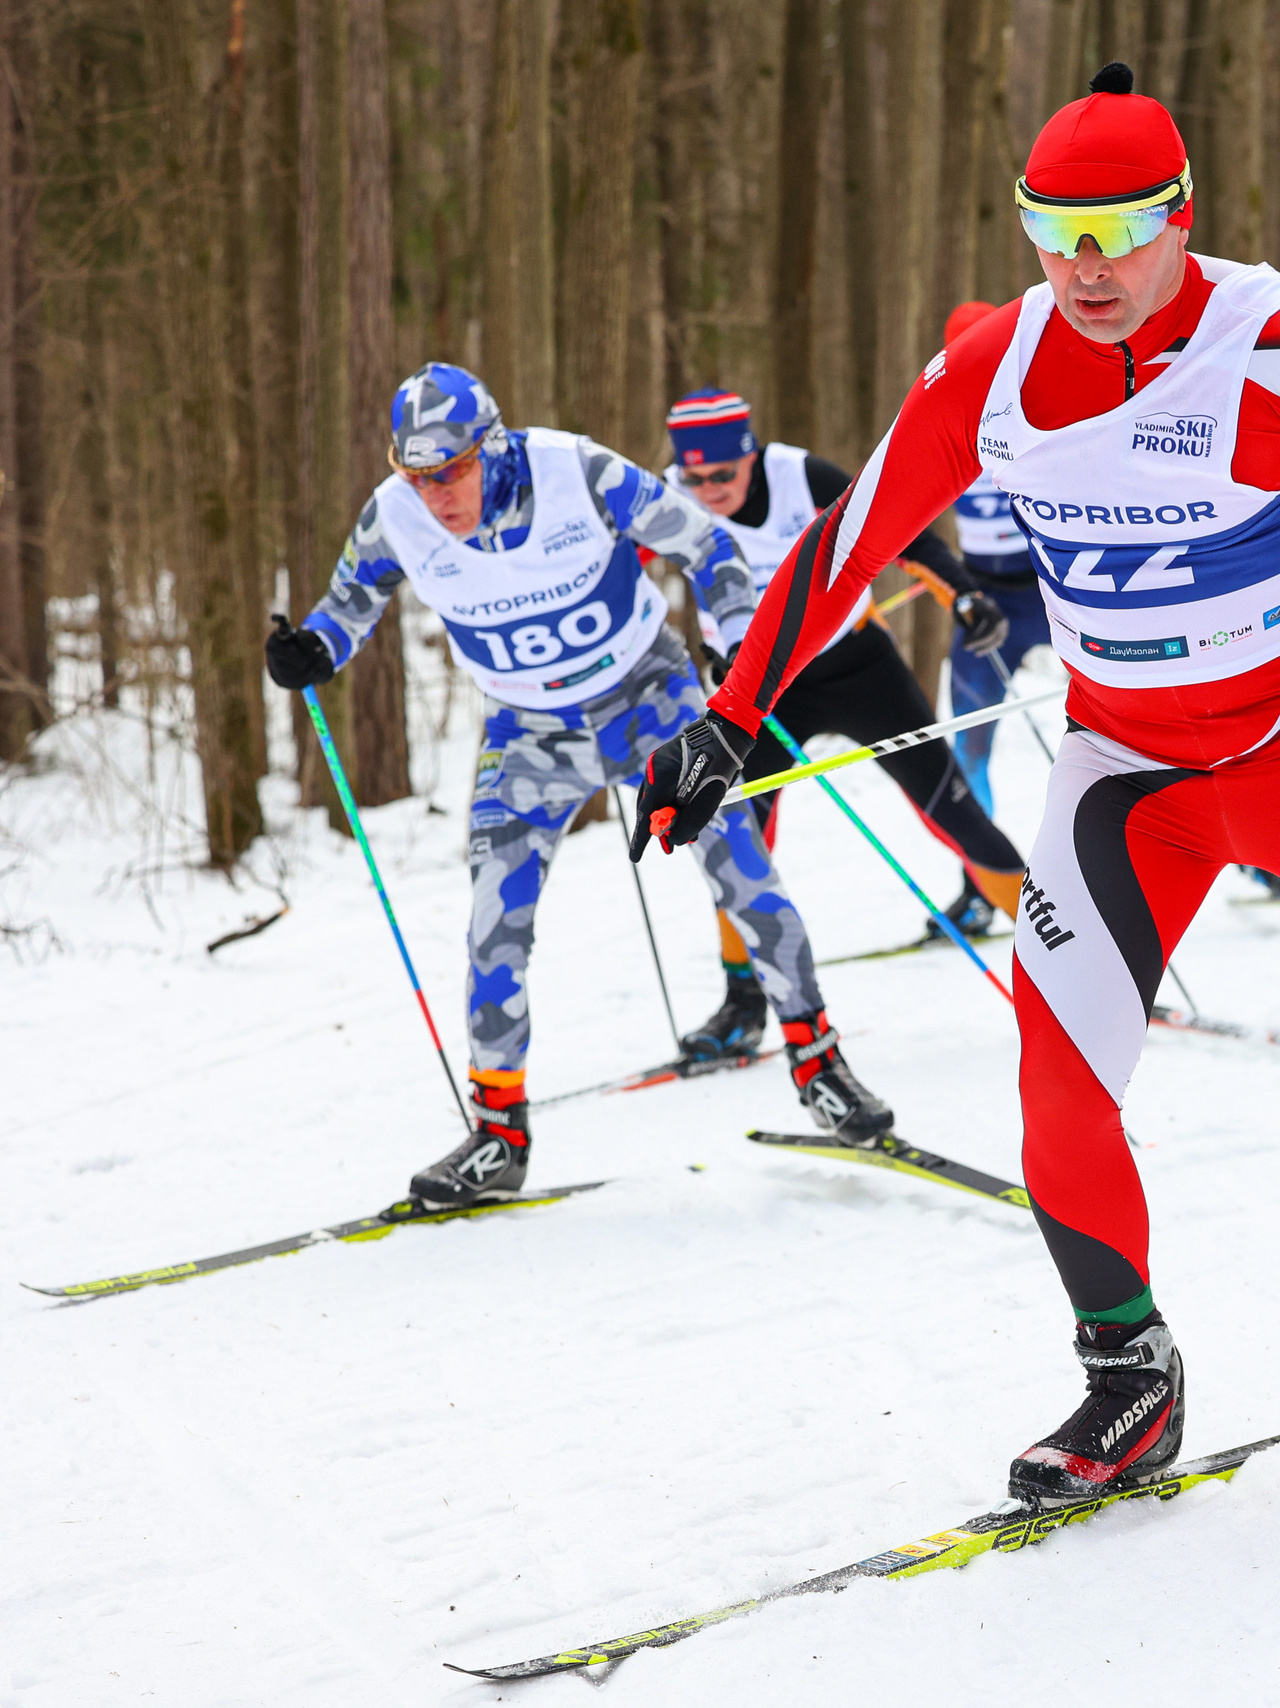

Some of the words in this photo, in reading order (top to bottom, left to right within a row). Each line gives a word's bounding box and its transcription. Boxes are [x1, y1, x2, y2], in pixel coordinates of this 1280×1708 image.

[1119, 204, 1168, 217] ONEWAY
[1135, 422, 1175, 434] VLADIMIR
[1174, 419, 1207, 438] SKI
[980, 436, 1009, 451] TEAM
[1131, 433, 1204, 457] PROKU
[980, 446, 1015, 462] PROKU
[474, 600, 613, 671] 180
[1022, 866, 1076, 952] ortful
[1080, 1354, 1140, 1367] MADSHUS
[1100, 1379, 1169, 1454] MADSHUS
